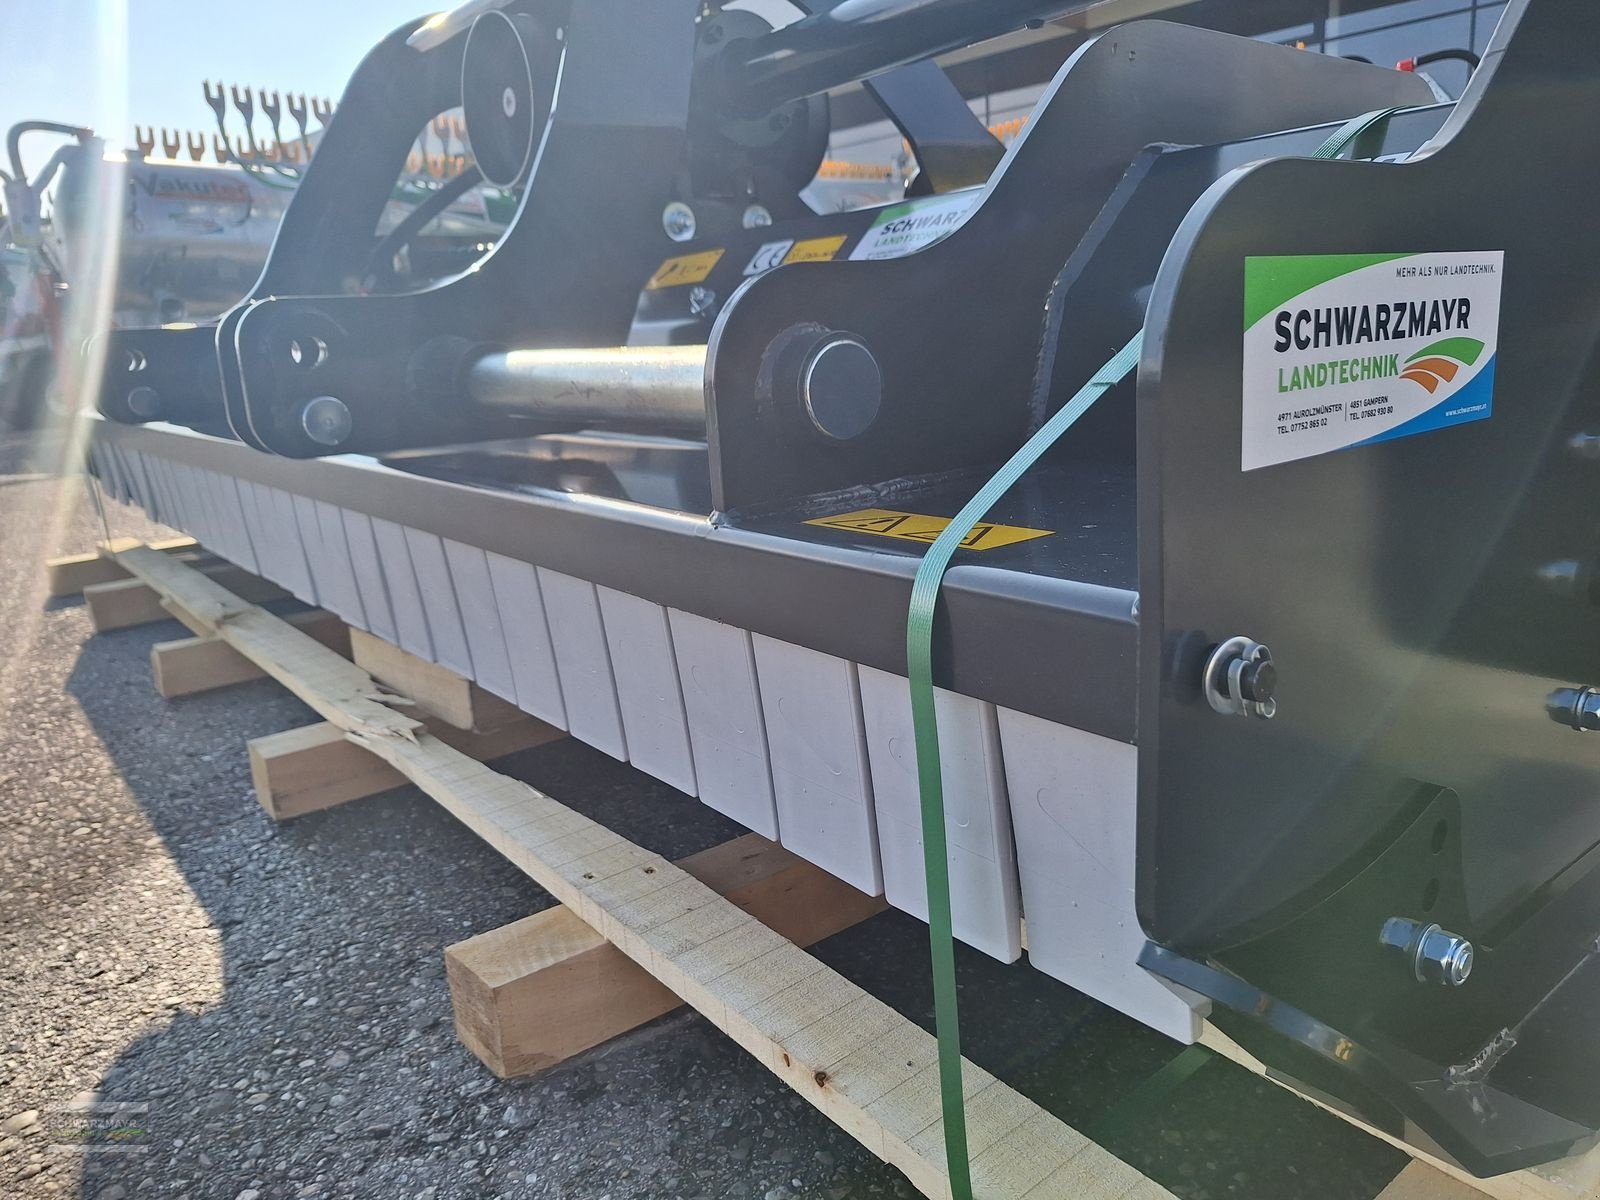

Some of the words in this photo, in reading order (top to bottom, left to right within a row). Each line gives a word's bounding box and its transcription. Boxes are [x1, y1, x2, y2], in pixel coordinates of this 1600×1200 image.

[1396, 267, 1416, 278] MEHR
[1418, 266, 1432, 277] ALS
[1434, 265, 1448, 276] NUR
[1450, 264, 1496, 275] LANDTECHNIK.
[1274, 298, 1471, 353] SCHWARZMAYR
[1278, 354, 1399, 393] LANDTECHNIK
[1350, 399, 1362, 409] 4851
[1363, 395, 1389, 407] GAMPERN
[1277, 412, 1292, 421] 4971
[1293, 403, 1343, 419] AUROLZMÜNSTER
[1377, 406, 1387, 416] 930
[1290, 421, 1308, 432] 07752
[1321, 417, 1328, 427] 02
